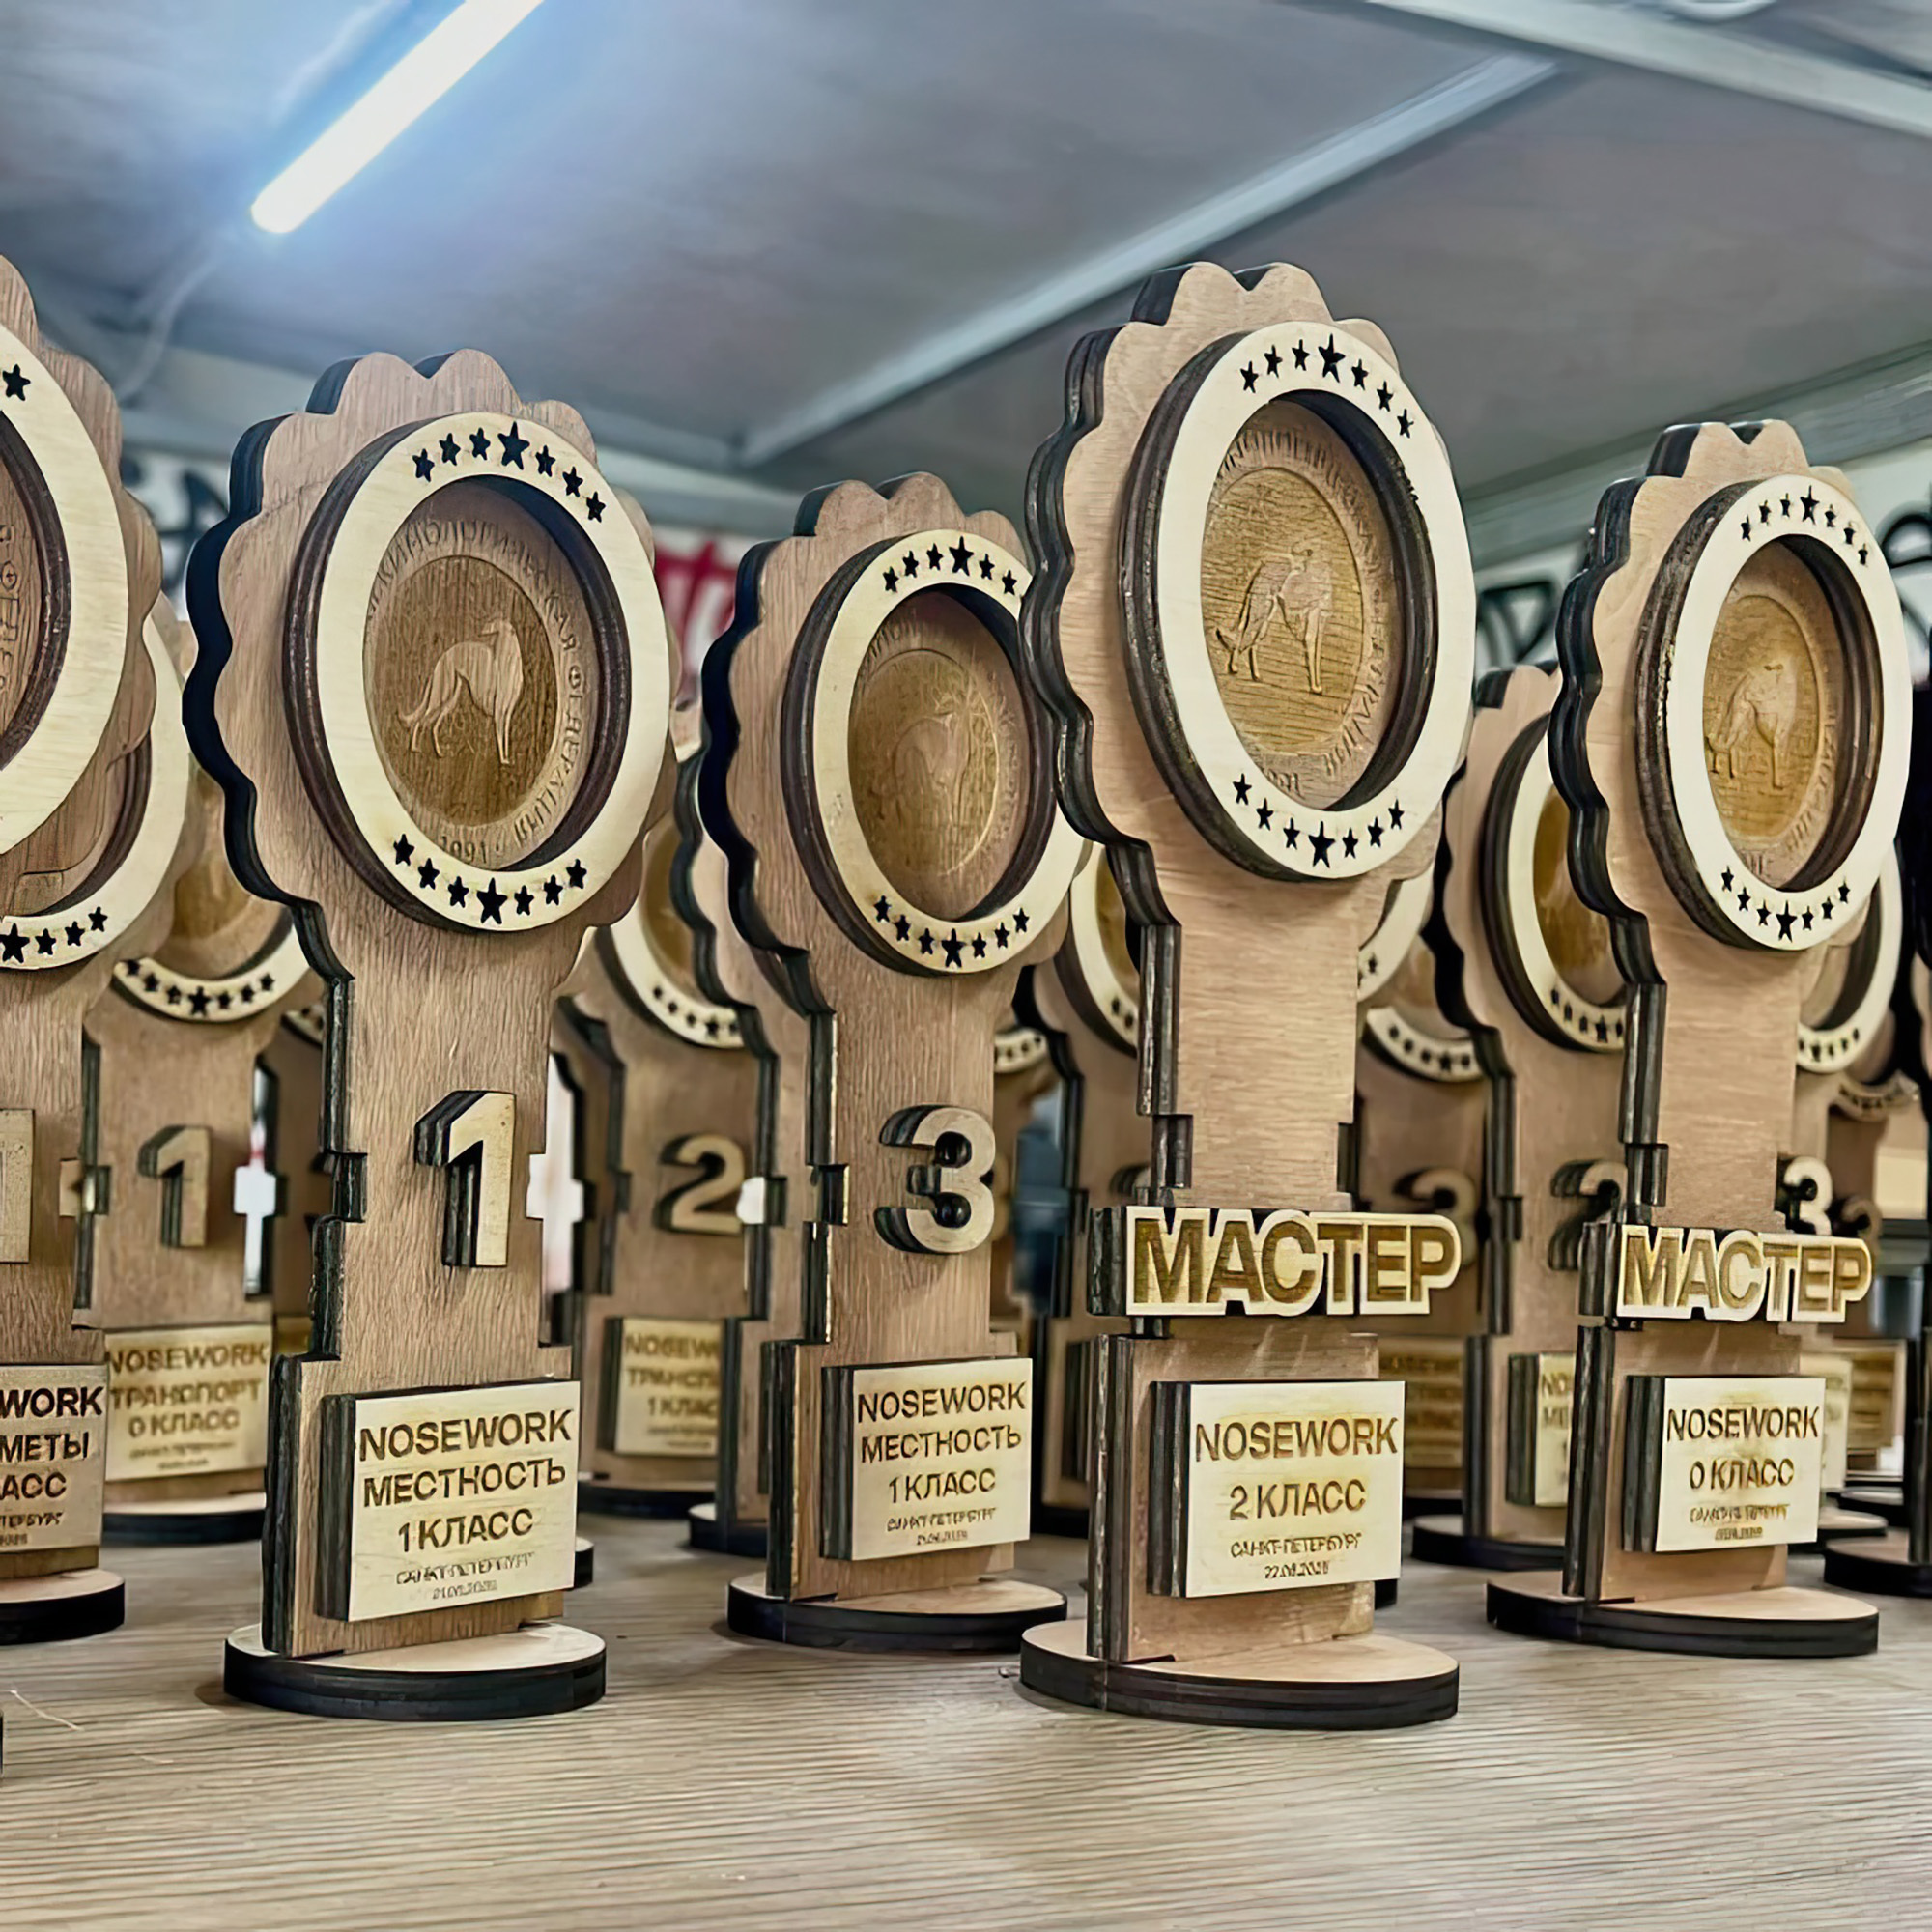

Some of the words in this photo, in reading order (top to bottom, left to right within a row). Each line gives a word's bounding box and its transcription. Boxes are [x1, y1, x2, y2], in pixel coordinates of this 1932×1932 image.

[156, 1126, 210, 1247] 1
[446, 1092, 515, 1266] 1
[671, 1133, 746, 1235] 2
[905, 1107, 997, 1254] 3
[1133, 1218, 1451, 1305] МАСТЕР
[1622, 1234, 1869, 1314] МАСТЕР
[150, 1408, 240, 1436] КЛАСС
[857, 1380, 1028, 1424] NOSEWORK
[1666, 1406, 1820, 1443] NOSEWORK
[358, 1408, 575, 1463] NOSEWORK
[860, 1424, 1023, 1464] МЕСТНОСТЬ
[1195, 1416, 1399, 1463] NOSEWORK
[362, 1457, 566, 1508] МЕСТНОСТЬ
[888, 1475, 898, 1504] 1
[904, 1467, 997, 1503] КЛАСС
[1710, 1457, 1795, 1491] КЛАСС
[1229, 1484, 1249, 1520] 2
[1256, 1478, 1367, 1520] КЛАСС
[398, 1521, 411, 1553] 1
[417, 1507, 534, 1550] КЛАСС
